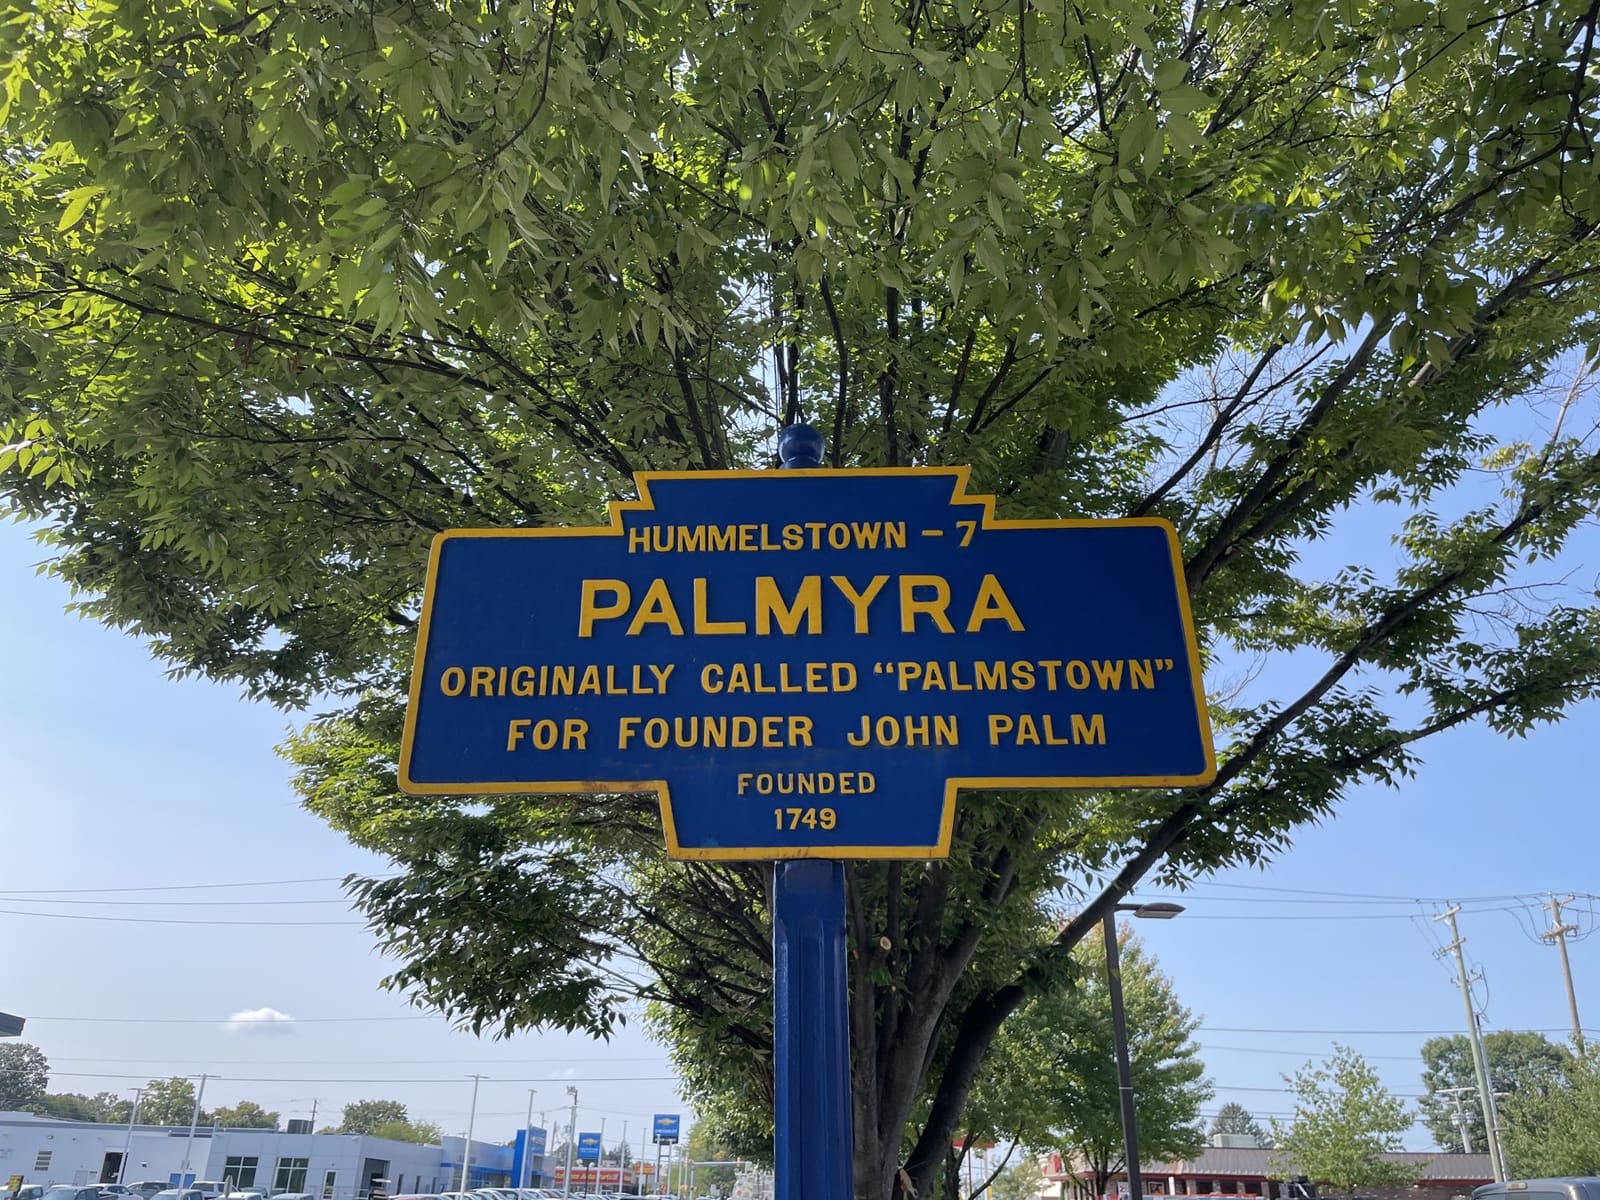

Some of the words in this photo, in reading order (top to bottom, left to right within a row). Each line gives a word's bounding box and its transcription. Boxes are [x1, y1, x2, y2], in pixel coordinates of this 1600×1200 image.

[629, 521, 906, 554] HUMMELSTOWN
[956, 520, 977, 547] 7
[578, 573, 1025, 638] PALMYRA
[440, 663, 674, 697] ORIGINALLY
[701, 662, 858, 694] CALLED
[874, 659, 1174, 692] “PALMSTOWN”
[507, 718, 589, 751] FOR
[617, 715, 813, 750] FOUNDER
[847, 715, 959, 747] JOHN
[988, 714, 1106, 746] PALM
[737, 772, 876, 796] FOUNDED
[775, 807, 837, 831] 1749
